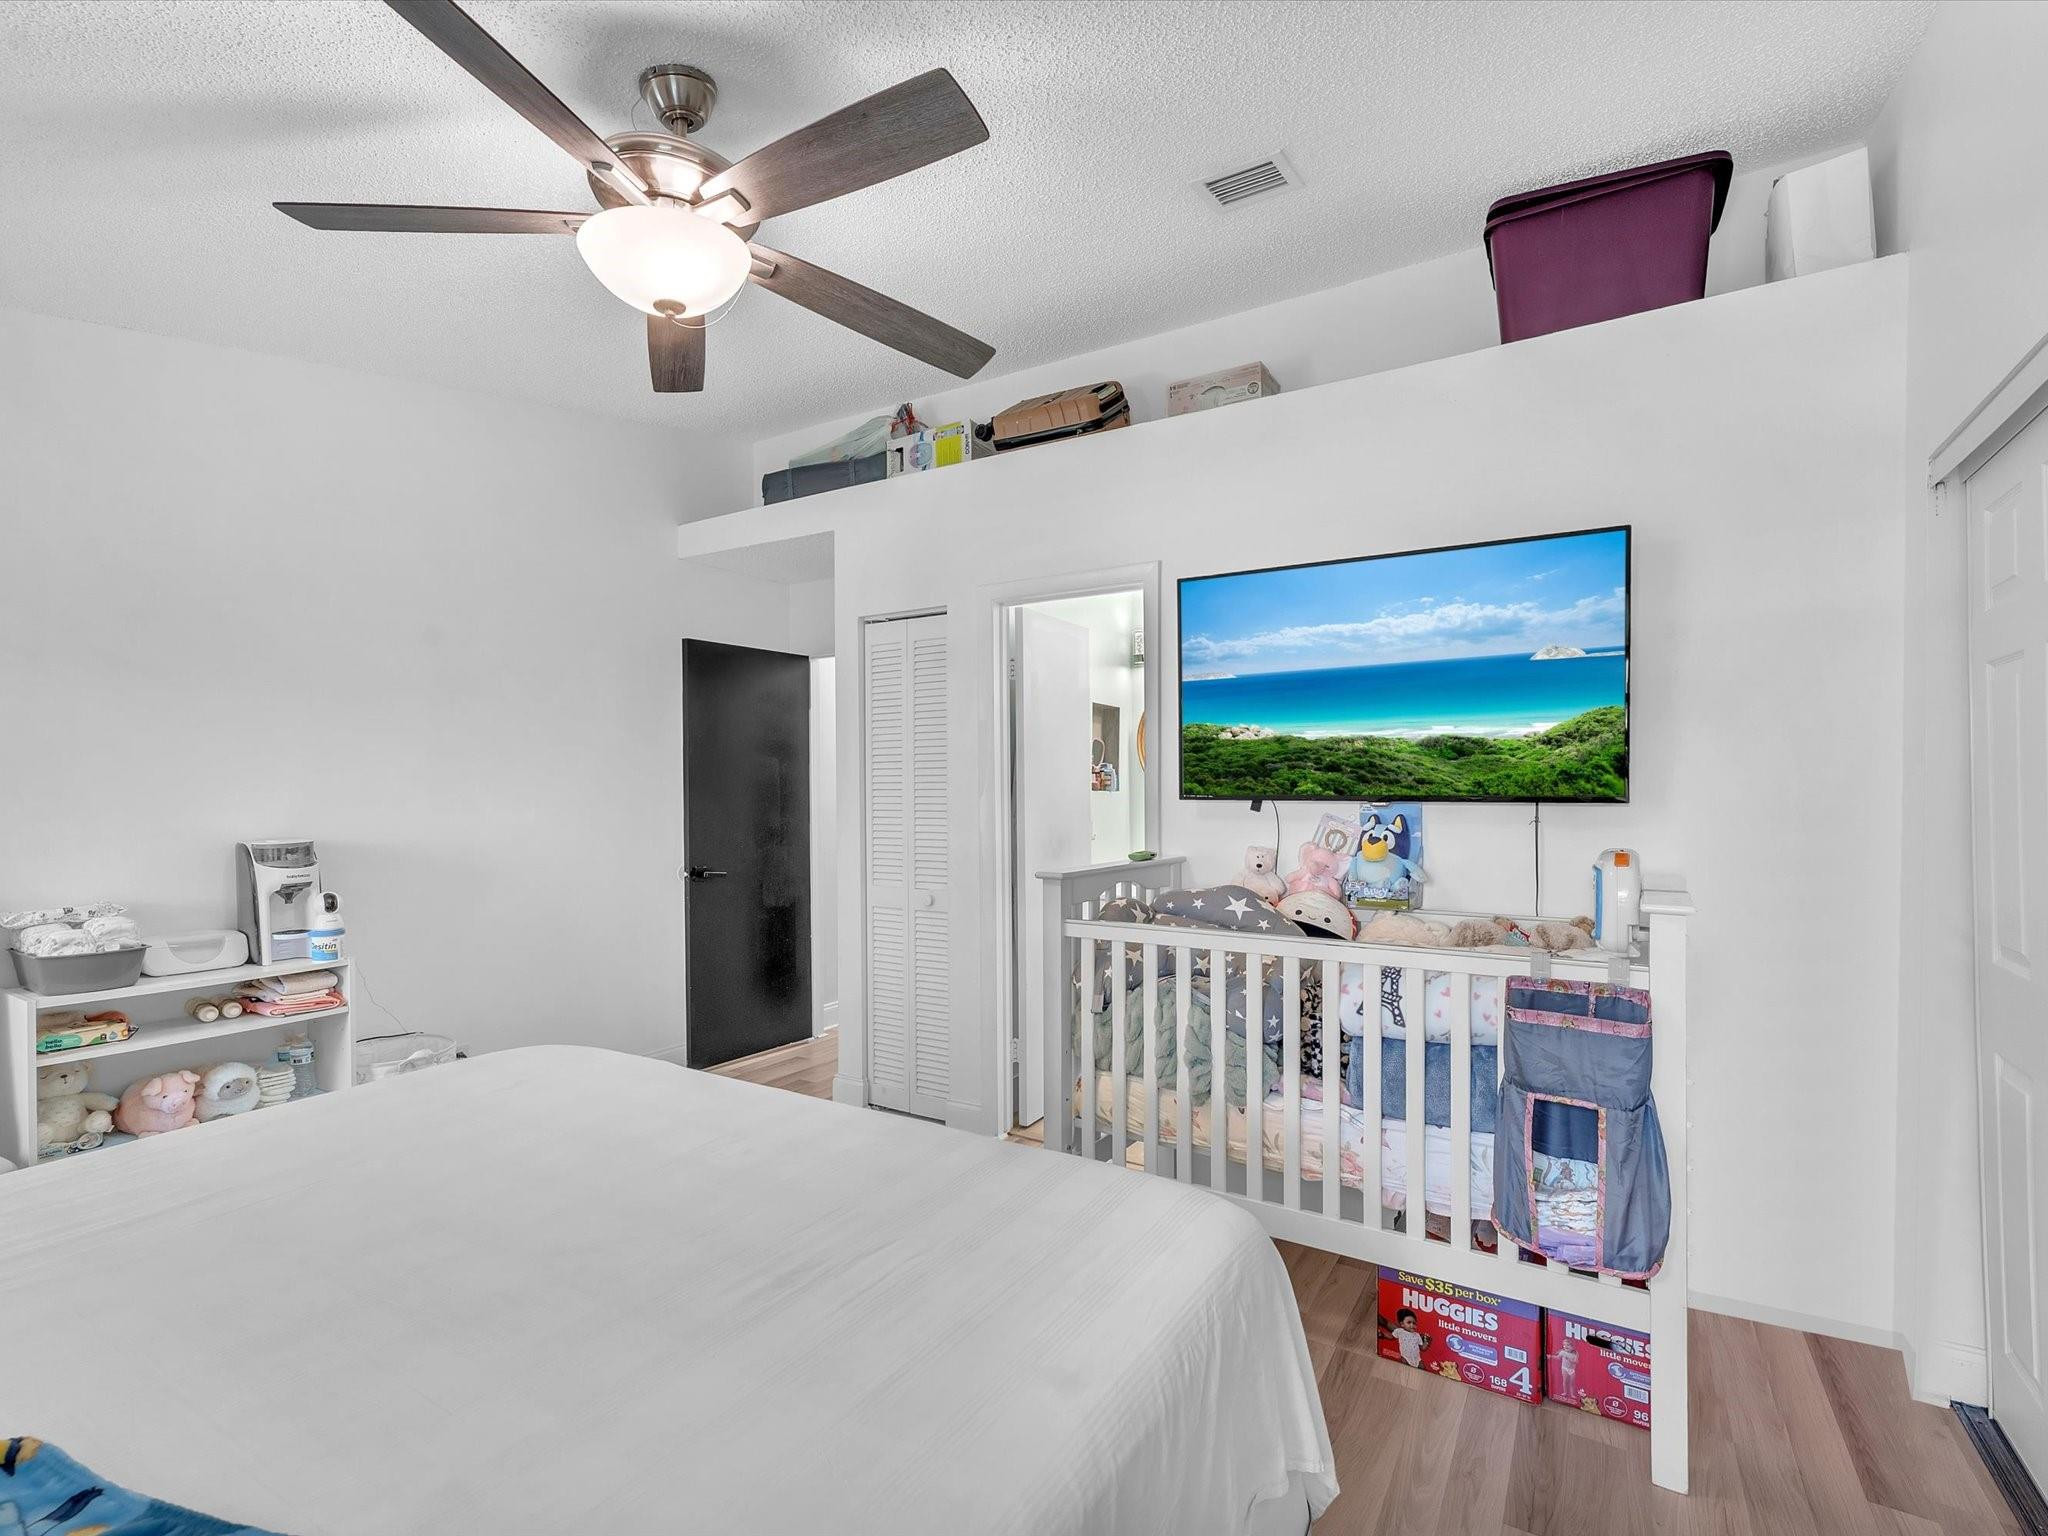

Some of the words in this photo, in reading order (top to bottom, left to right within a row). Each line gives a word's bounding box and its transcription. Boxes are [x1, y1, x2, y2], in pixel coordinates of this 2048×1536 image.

[1398, 1272, 1424, 1286] Save
[1425, 1278, 1453, 1296] $35
[1455, 1287, 1474, 1300] per
[1402, 1288, 1498, 1331] HUGGIES
[1438, 1318, 1461, 1333] little
[1461, 1327, 1498, 1344] movers
[1600, 1349, 1622, 1362] little
[1623, 1356, 1651, 1369] move
[1489, 1375, 1508, 1388] 168
[1509, 1366, 1533, 1395] 4
[1633, 1410, 1649, 1422] 96
